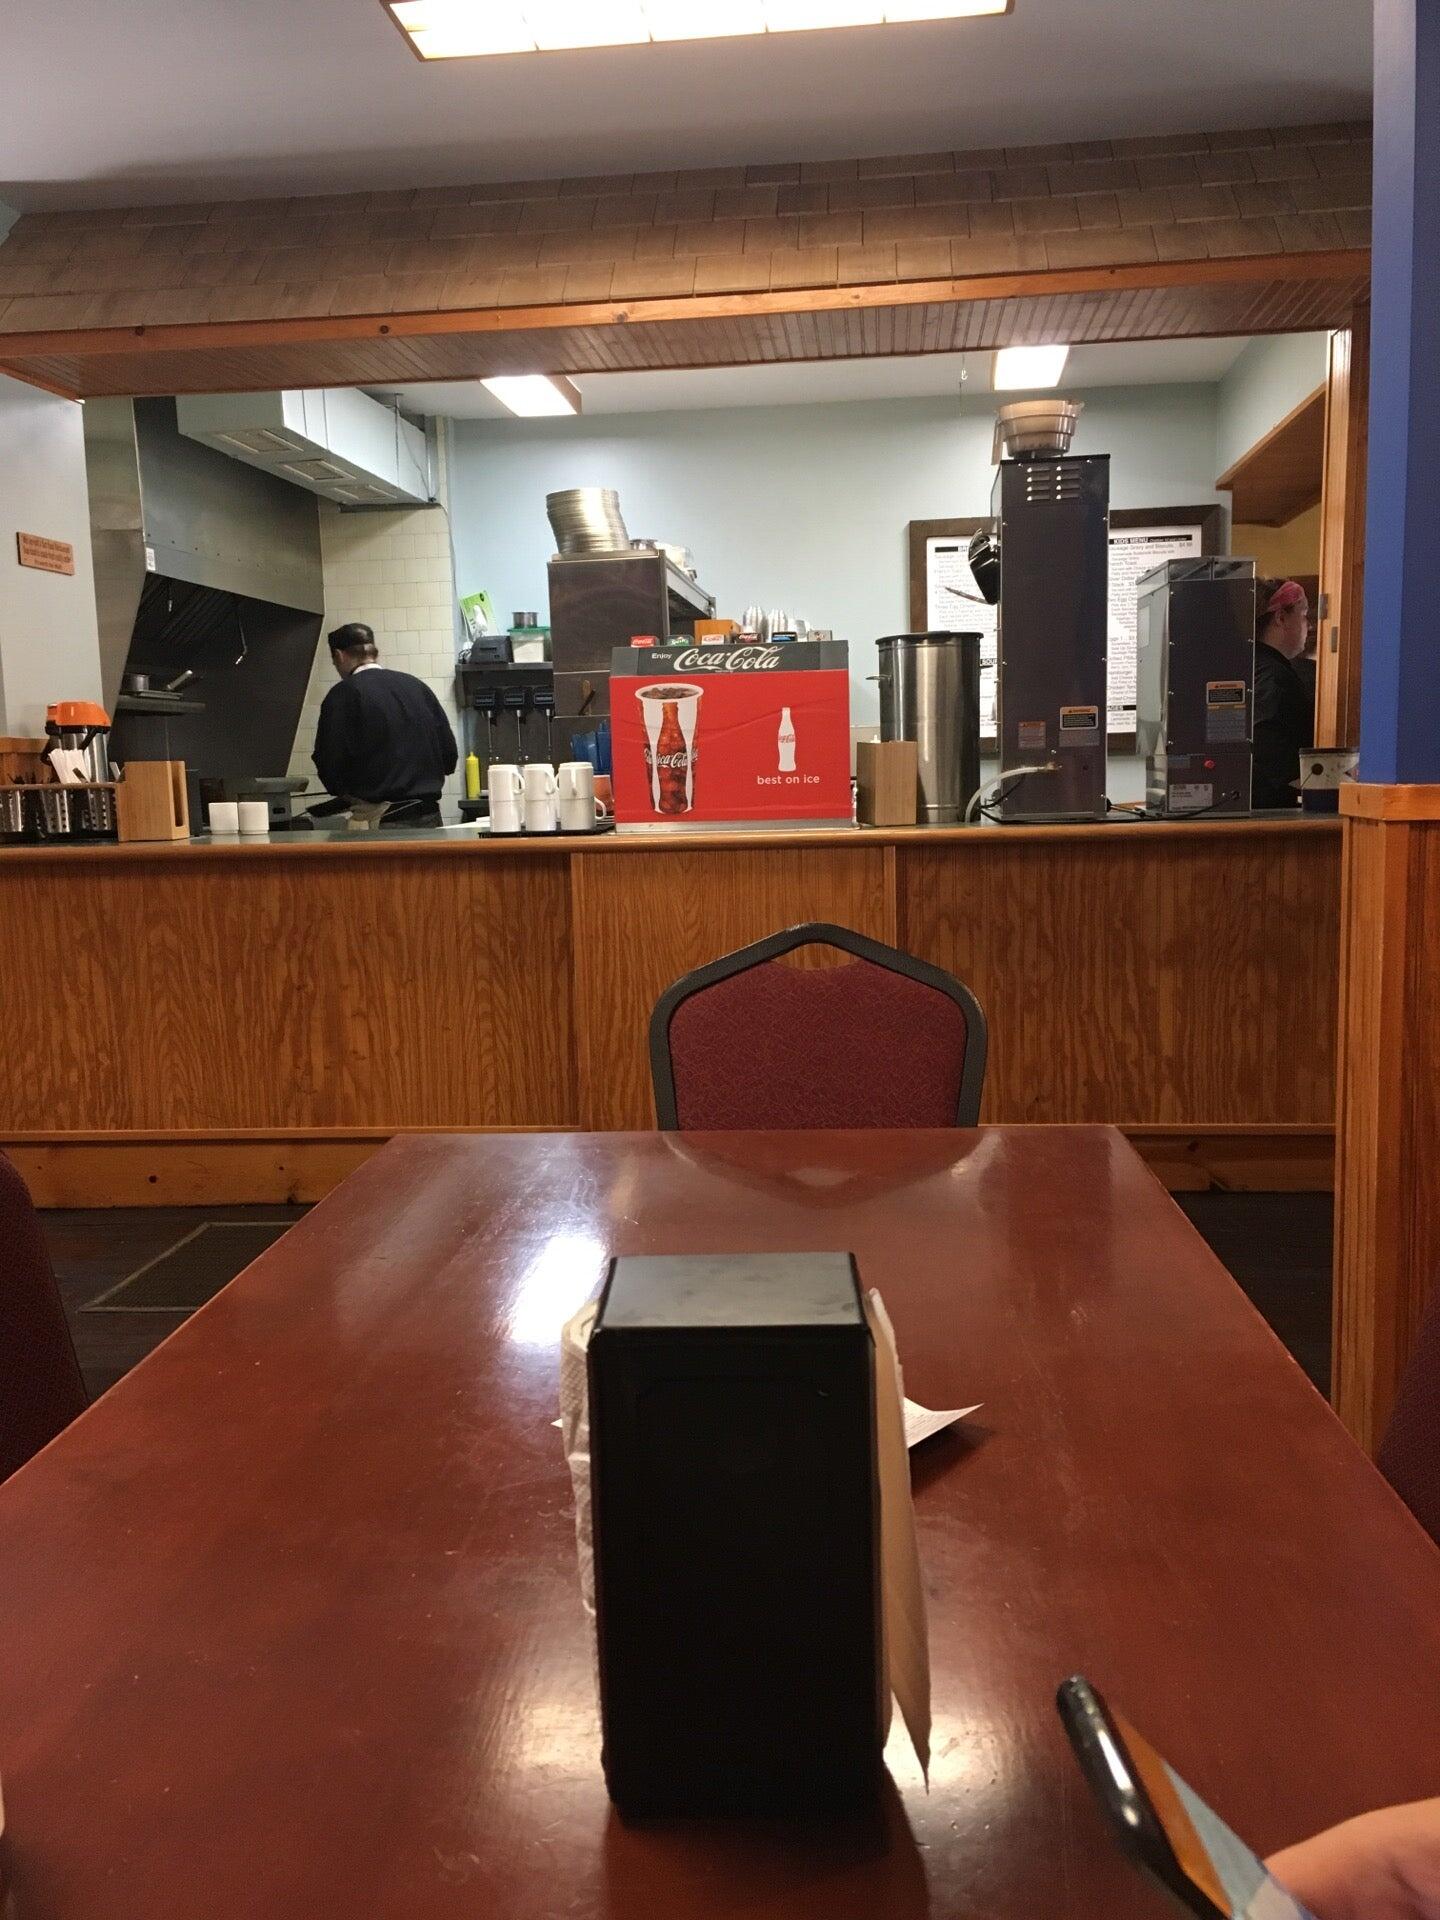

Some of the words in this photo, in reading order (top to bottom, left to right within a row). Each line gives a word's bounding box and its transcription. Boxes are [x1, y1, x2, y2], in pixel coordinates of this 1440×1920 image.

[651, 652, 673, 661] Enjoy
[673, 645, 785, 672] Coca-Cola
[757, 775, 782, 785] best
[785, 776, 800, 784] on
[803, 774, 820, 784] ice
